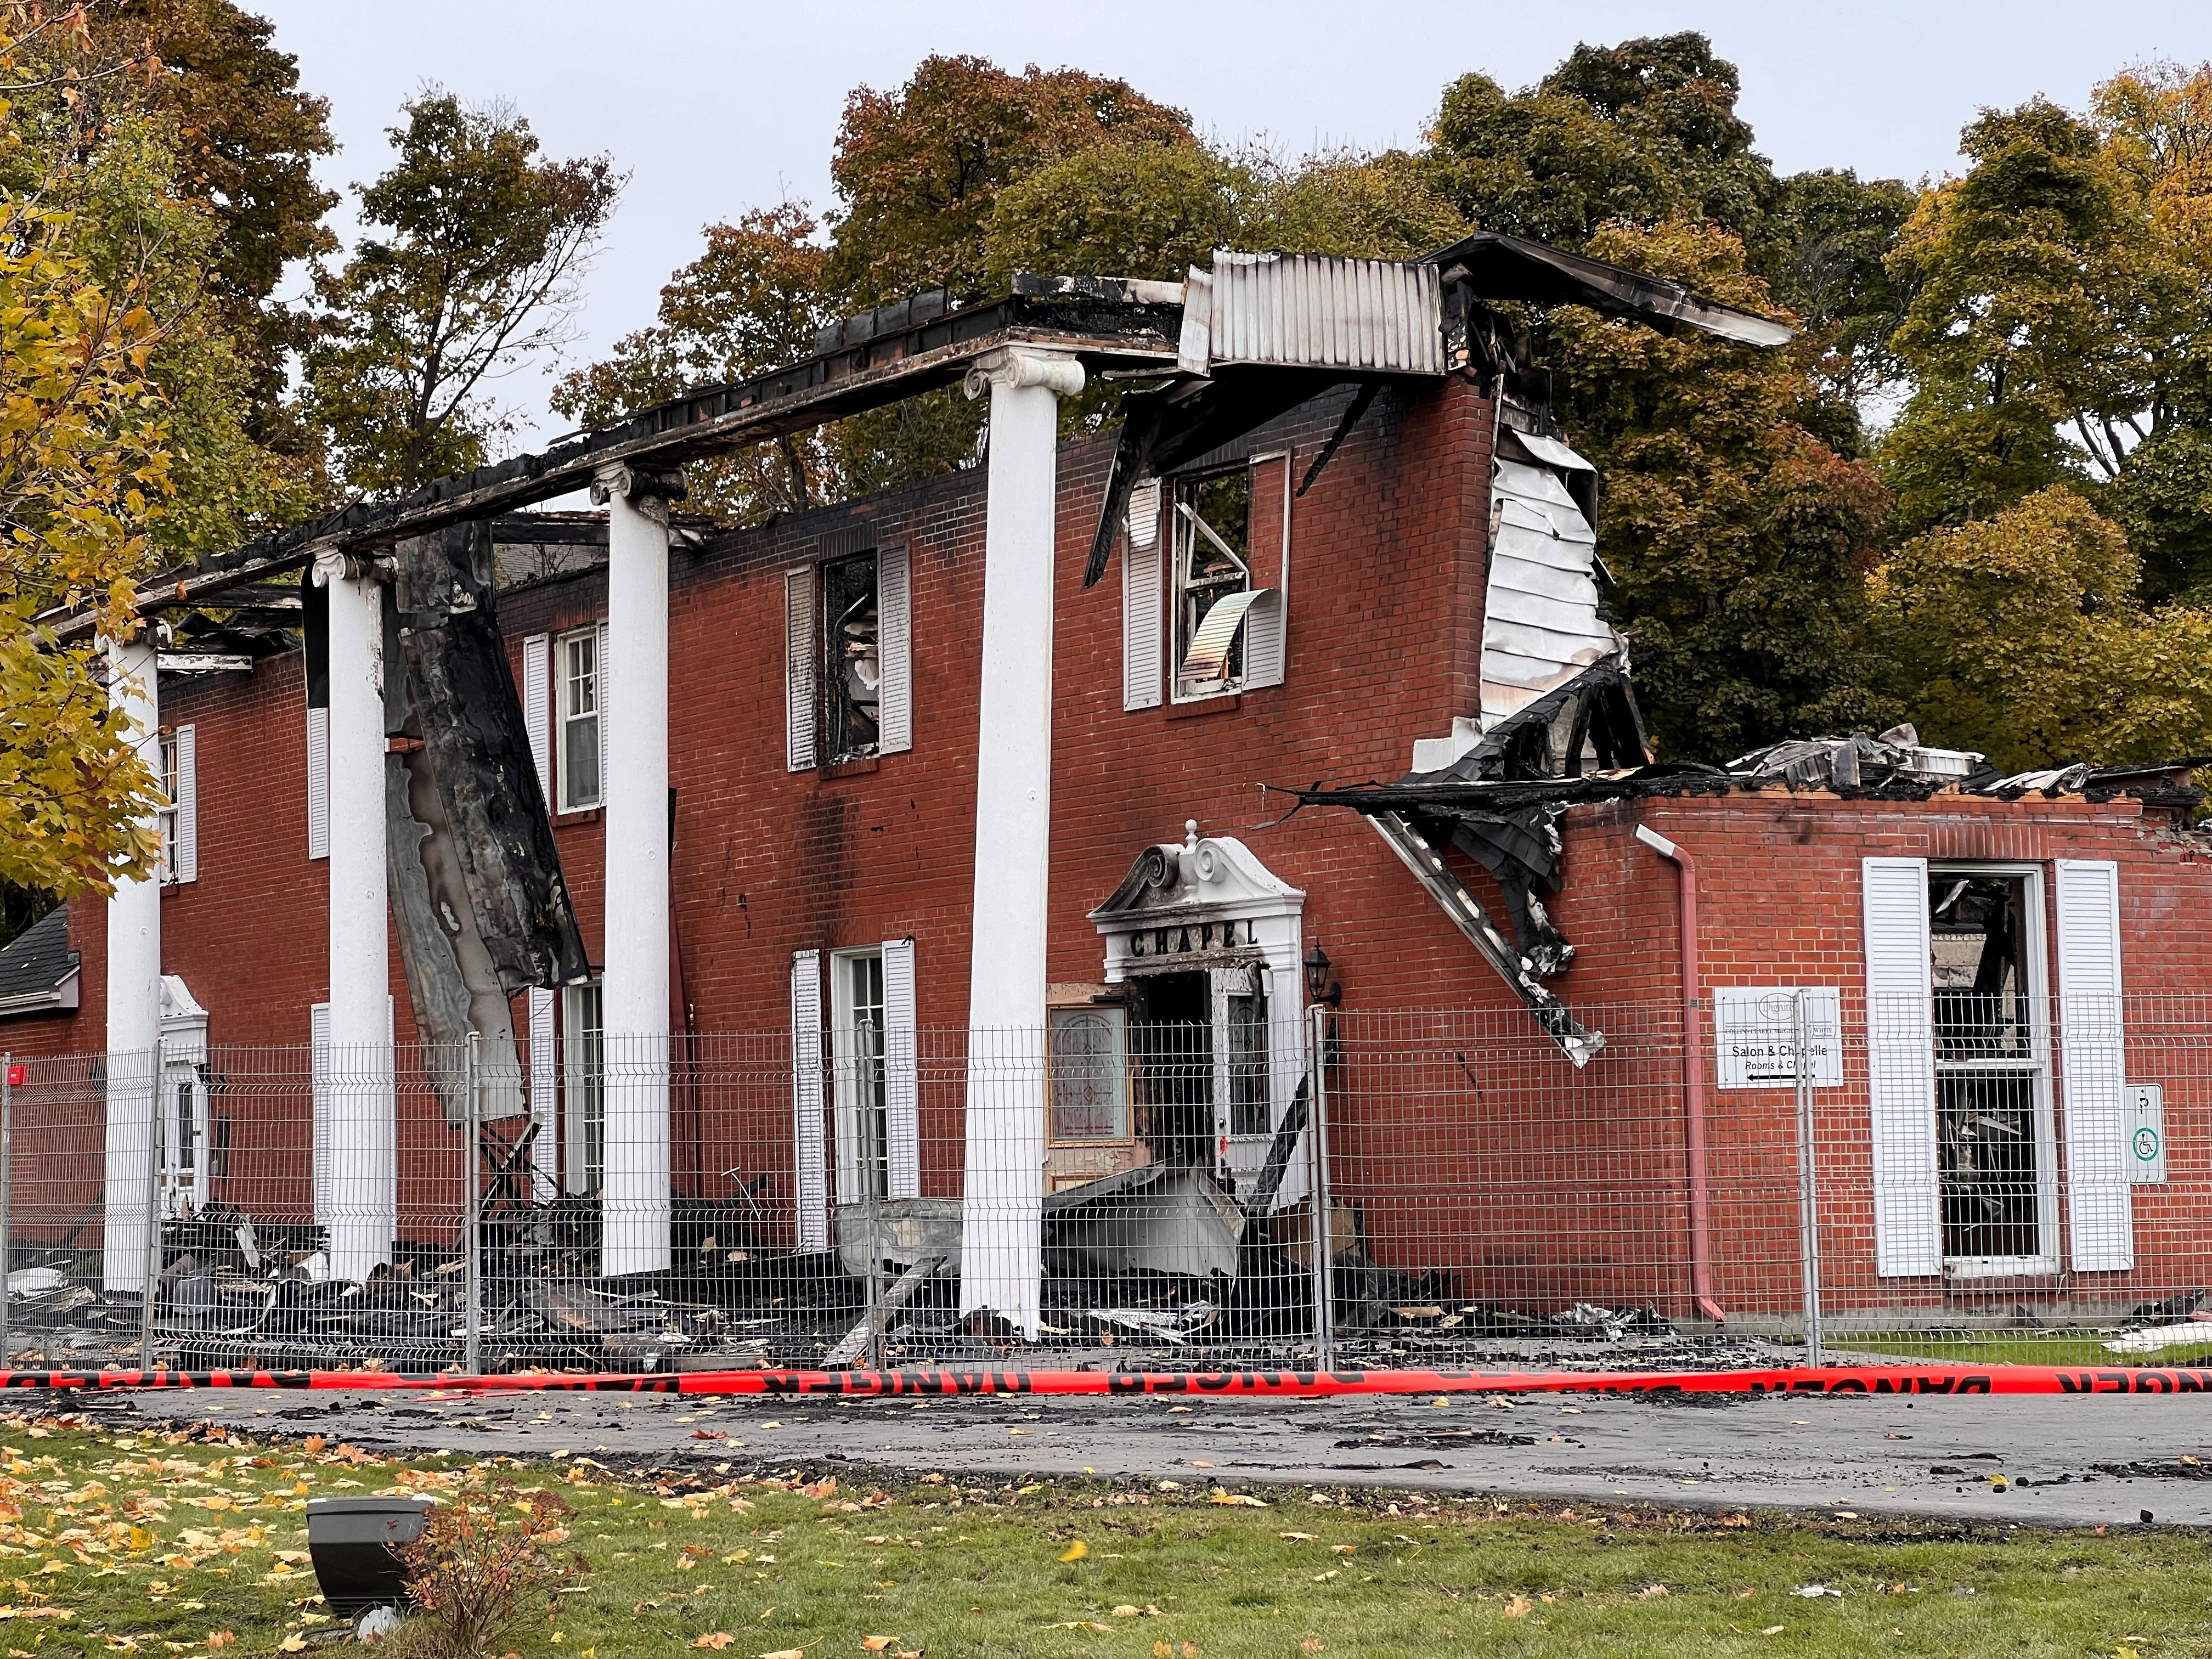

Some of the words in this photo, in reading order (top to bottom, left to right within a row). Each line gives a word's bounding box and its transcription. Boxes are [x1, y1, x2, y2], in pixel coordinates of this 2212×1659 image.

[1131, 920, 1258, 957] CHAPEL
[1732, 1046, 1763, 1057] Salon
[1768, 1046, 1775, 1056] &
[1780, 1045, 1827, 1059] Chpelle
[1745, 1062, 1775, 1070] Rooms
[1778, 1061, 1784, 1069] &
